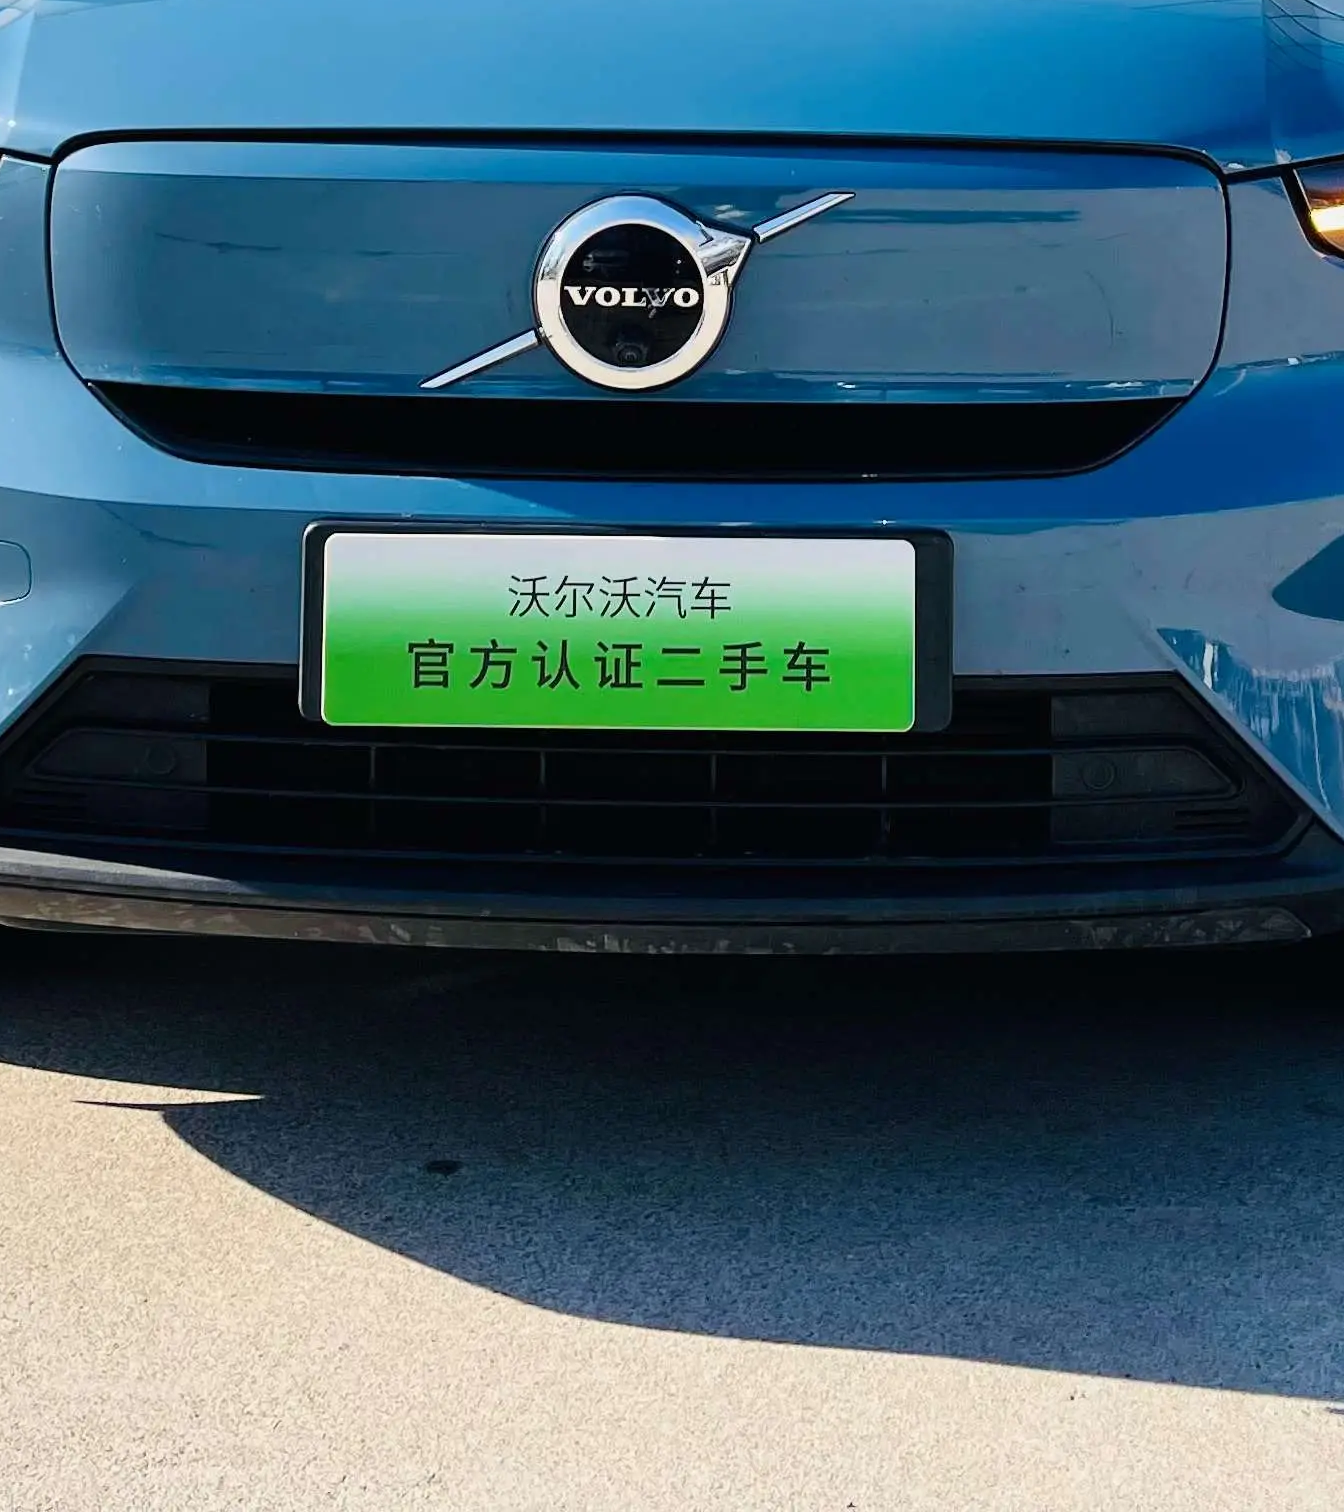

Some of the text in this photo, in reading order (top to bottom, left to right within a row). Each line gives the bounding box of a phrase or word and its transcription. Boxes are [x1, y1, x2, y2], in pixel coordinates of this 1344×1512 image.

[564, 285, 700, 308] VOLVO
[508, 575, 732, 619] 沃尔沃汽车
[407, 639, 831, 692] 官方认证二手车
